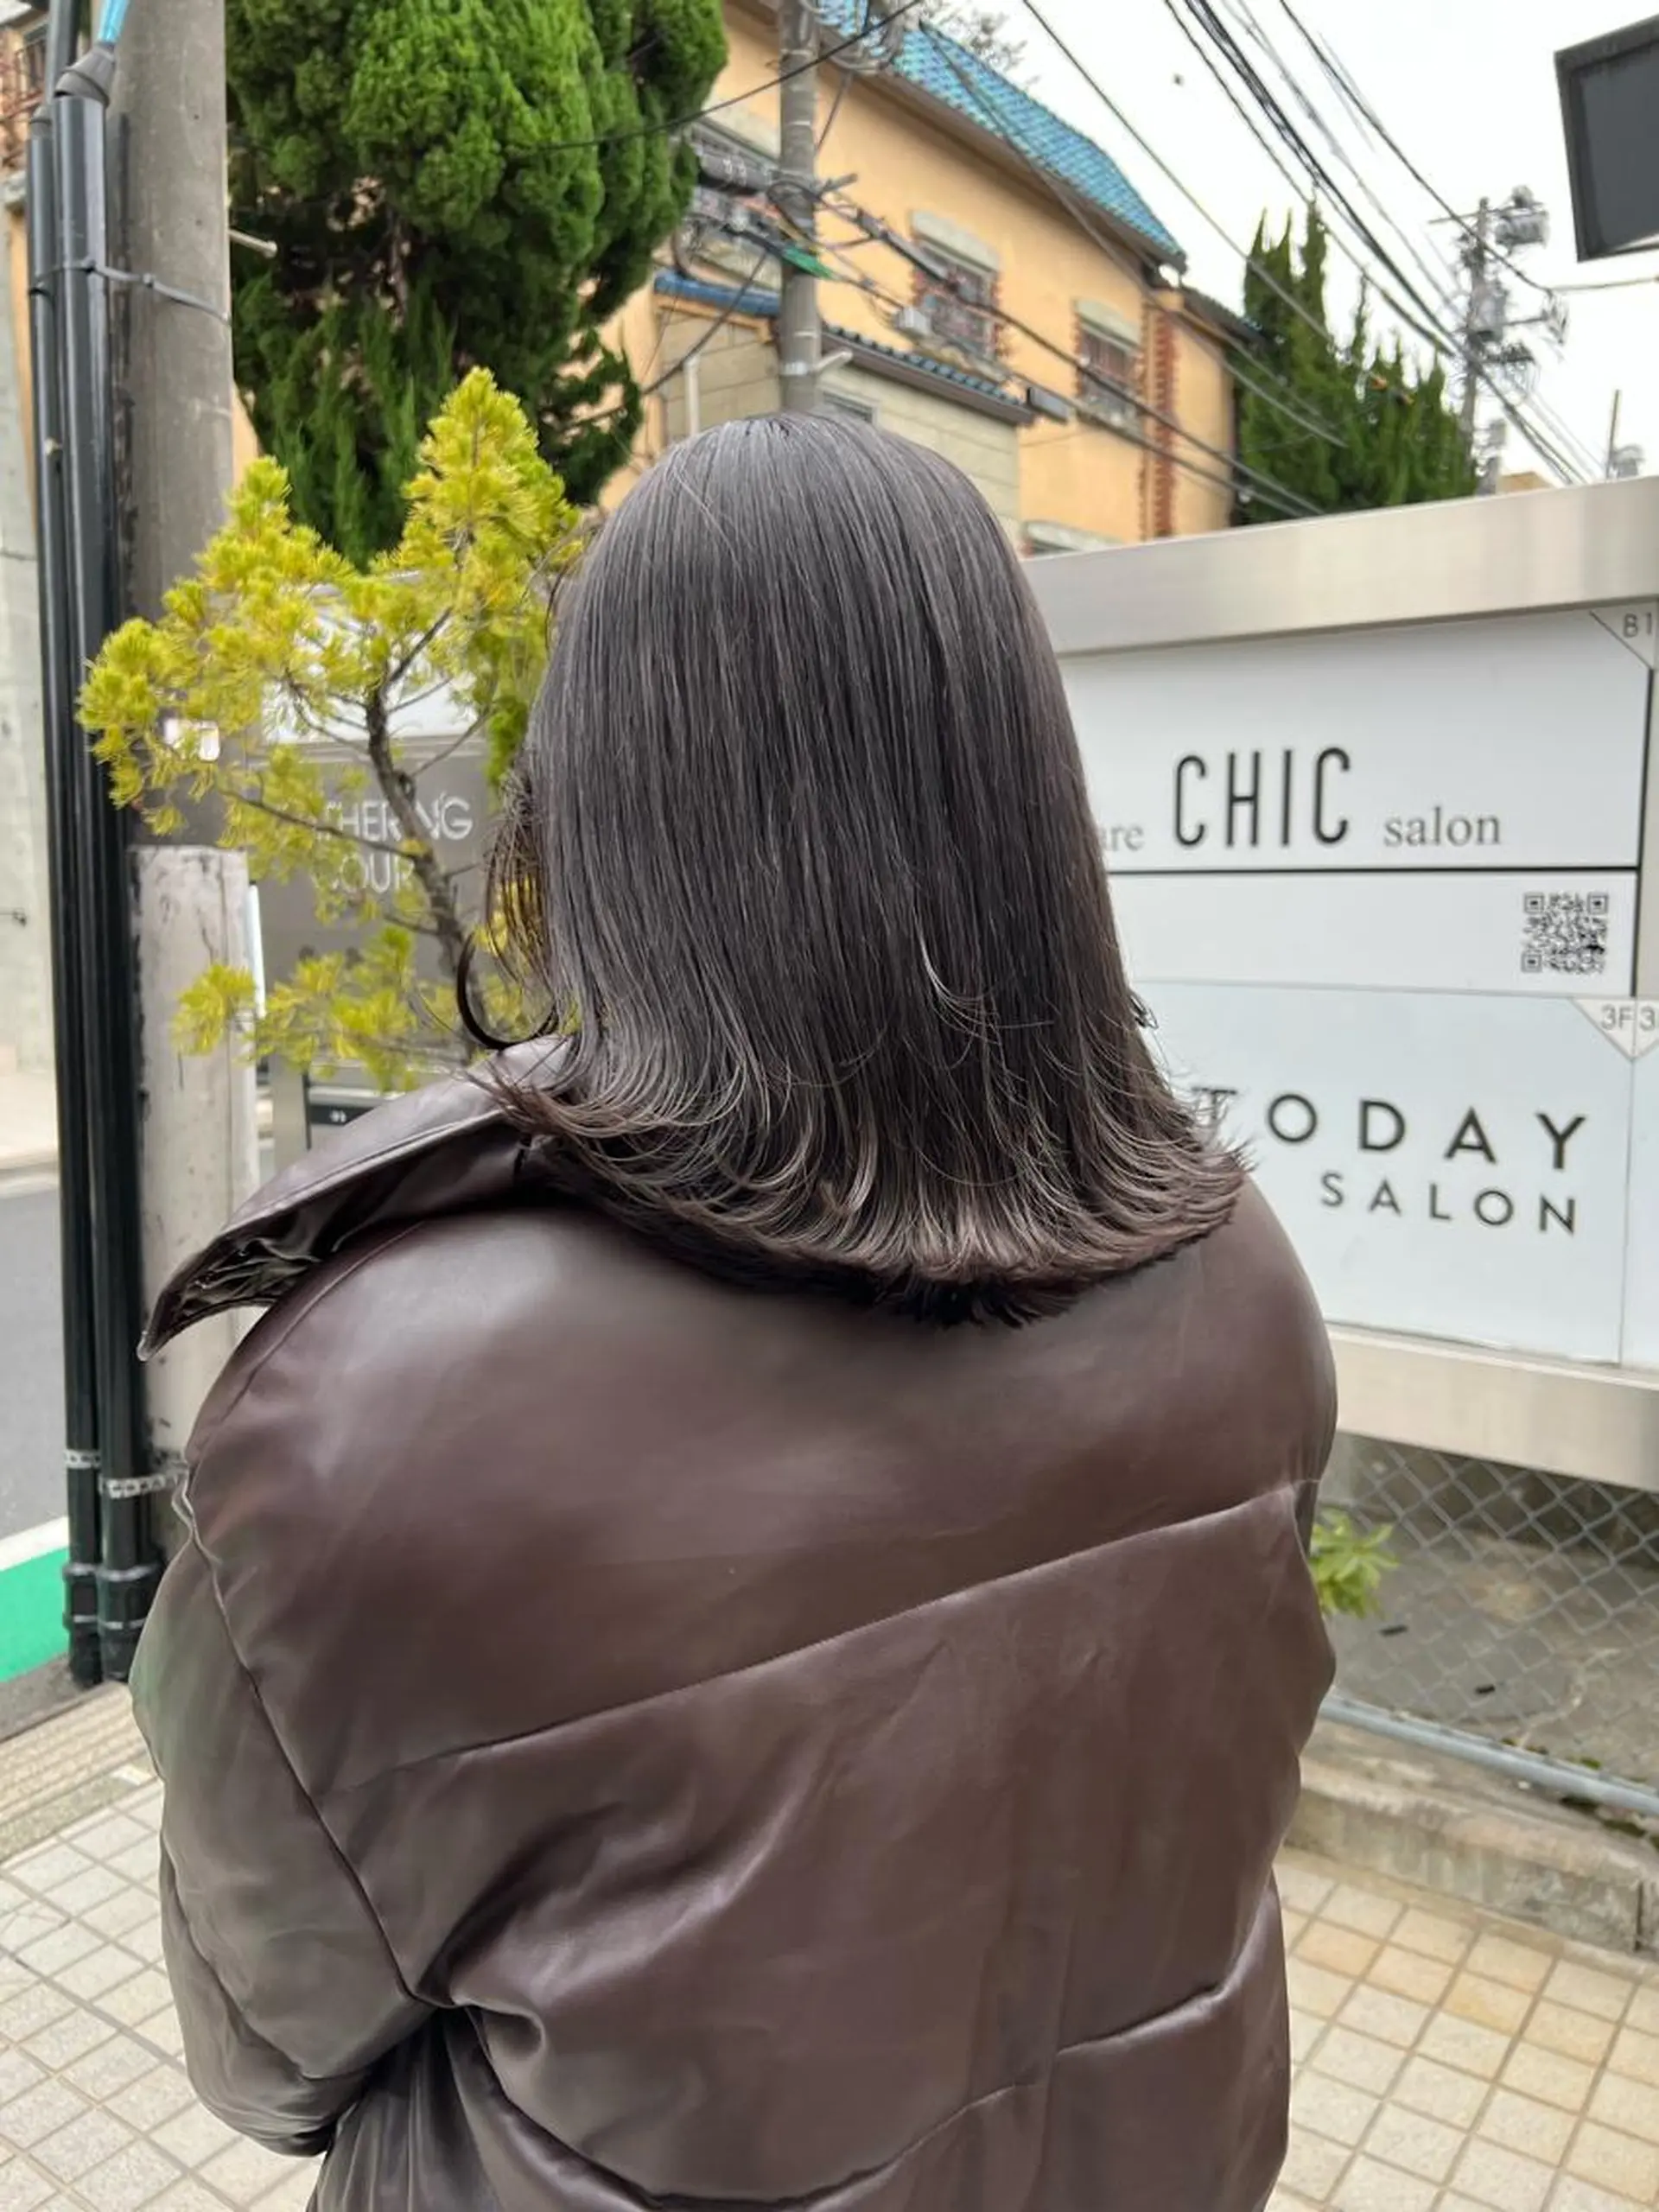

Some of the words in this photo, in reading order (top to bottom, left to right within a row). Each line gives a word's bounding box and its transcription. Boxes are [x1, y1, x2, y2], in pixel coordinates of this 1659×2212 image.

[1623, 611, 1653, 639] B1
[1173, 746, 1352, 849] CHIC
[1382, 805, 1502, 848] salon
[1601, 1004, 1632, 1030] 3F
[1191, 1087, 1587, 1171] TODAY
[1320, 1170, 1577, 1235] SALON
